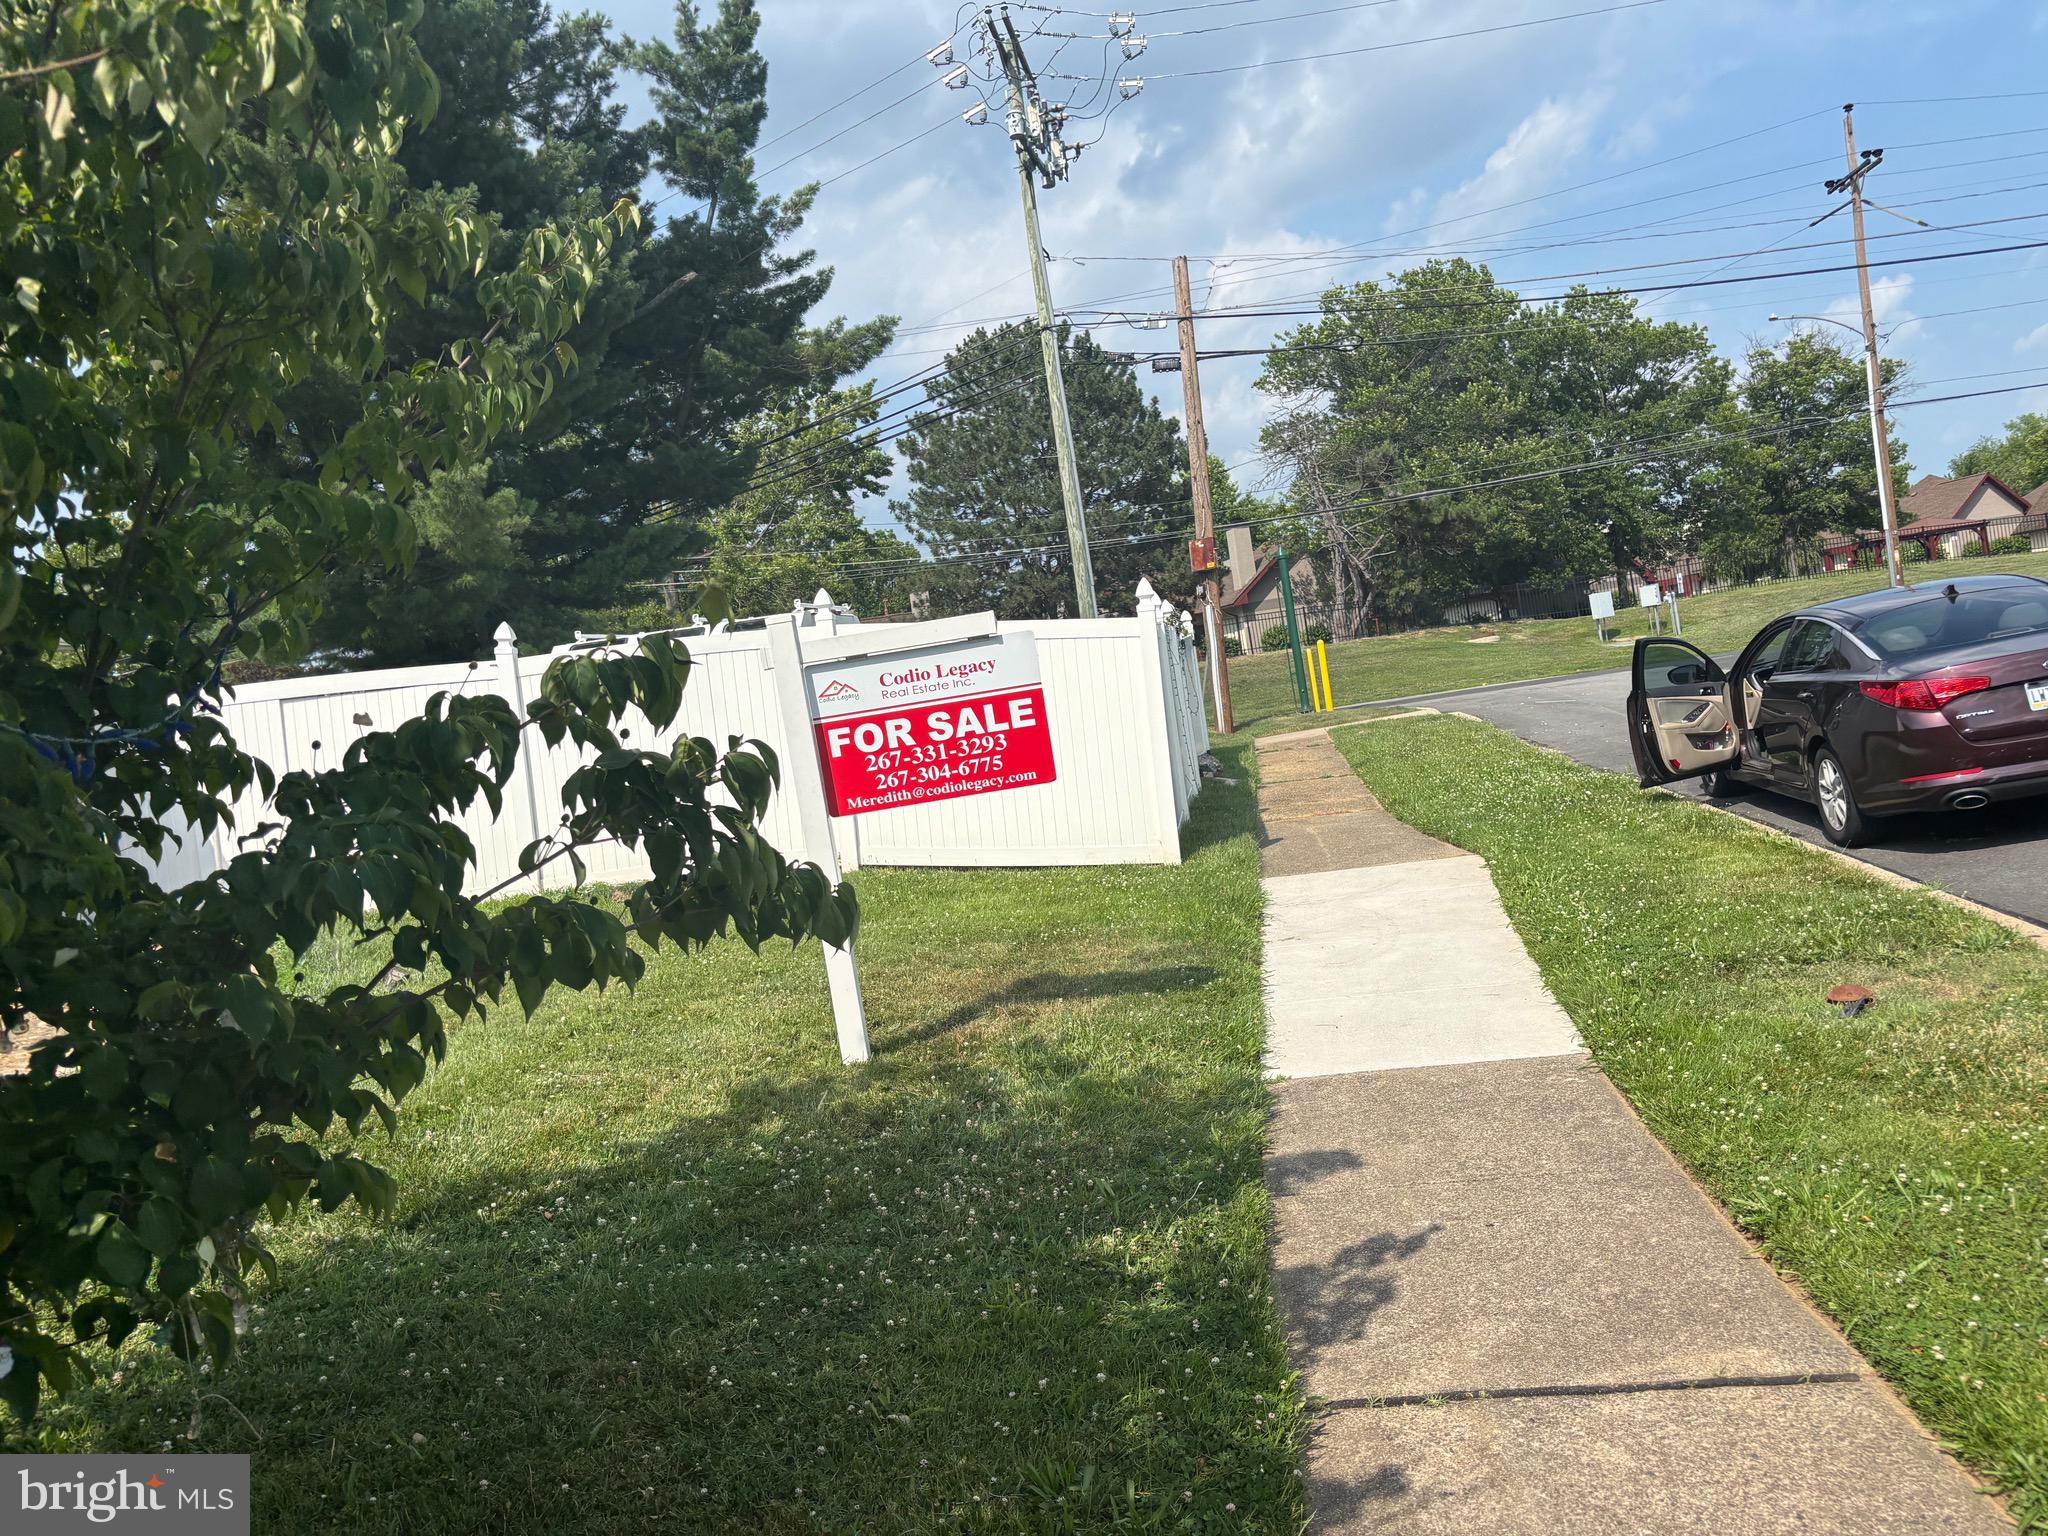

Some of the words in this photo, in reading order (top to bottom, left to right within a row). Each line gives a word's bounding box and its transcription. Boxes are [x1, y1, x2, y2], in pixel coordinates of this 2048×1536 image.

[879, 668, 930, 687] Codio
[936, 659, 996, 680] Legacy
[881, 687, 909, 700] Real
[912, 682, 949, 697] Estate
[953, 677, 976, 688] Inc.
[837, 693, 860, 702] Legacy
[827, 717, 917, 758] FOR
[927, 697, 1037, 742] SALE
[864, 733, 1008, 772] 267-331-3293
[846, 769, 1037, 810] Meredith@codiolegacy.com
[875, 754, 1003, 790] 267-304-6775
